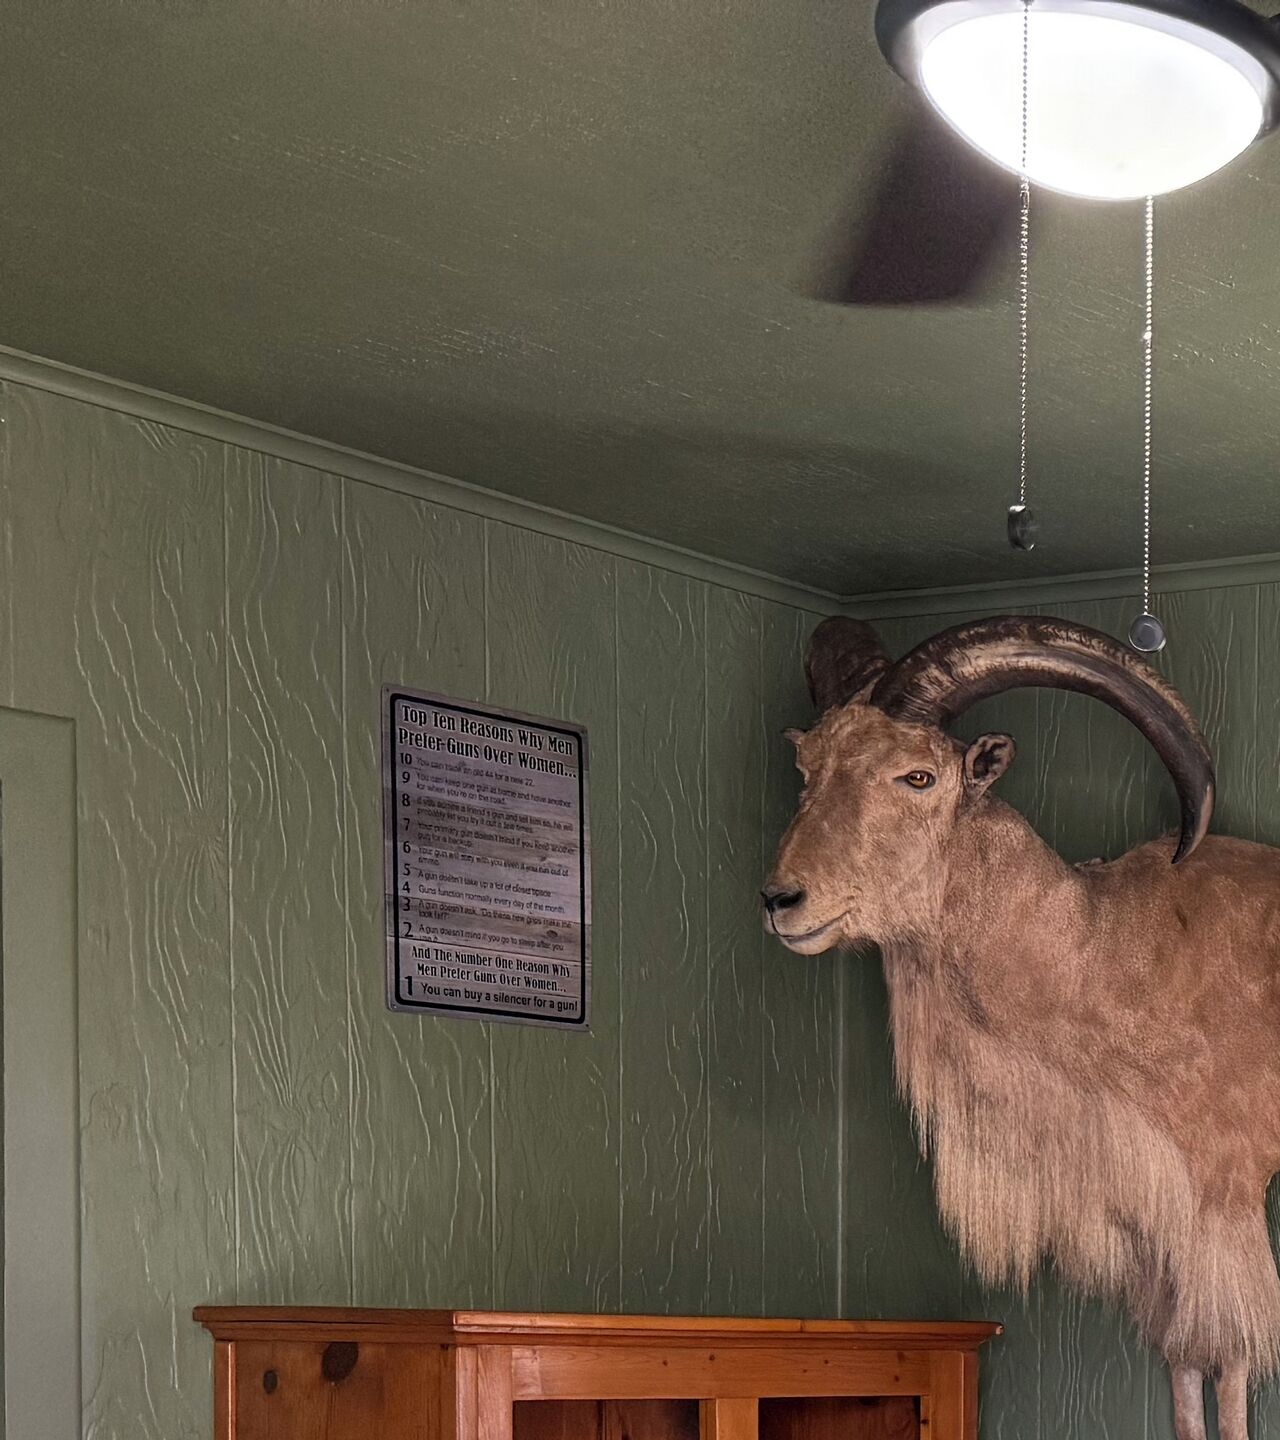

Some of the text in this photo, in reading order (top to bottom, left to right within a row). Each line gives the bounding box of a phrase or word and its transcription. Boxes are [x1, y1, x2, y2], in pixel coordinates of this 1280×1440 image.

[401, 705, 572, 755] Top Ten Reasons Why Men
[398, 727, 575, 778] Prefer Guns Over Women...
[400, 752, 411, 765] 10
[416, 757, 429, 767] You
[402, 771, 410, 784] 9
[416, 773, 428, 782] You
[462, 781, 475, 790] one
[517, 790, 529, 800] and
[478, 793, 488, 801] the
[401, 793, 410, 807] 8
[505, 811, 516, 821] and
[403, 817, 410, 831] 7
[521, 839, 533, 849] you
[403, 840, 410, 853] 6
[490, 858, 502, 867] you
[402, 863, 410, 875] 5
[424, 871, 437, 881] gun
[494, 881, 503, 889] lot
[402, 880, 410, 893] 4
[418, 885, 436, 894] Guns
[438, 887, 463, 898] function
[465, 891, 491, 904] normally
[494, 896, 511, 907] every
[513, 898, 524, 909] day
[533, 902, 543, 910] the
[402, 897, 410, 911] 3
[425, 901, 437, 911] gun
[403, 921, 413, 937] 2
[425, 925, 438, 935] gun
[487, 933, 499, 944] you
[552, 942, 563, 952] you
[412, 945, 569, 977] And The Number One Reason Why
[417, 962, 566, 993] Men Prefer Guns Over Women...
[404, 975, 577, 1014] 1 You can buy a silencer for a gun!
